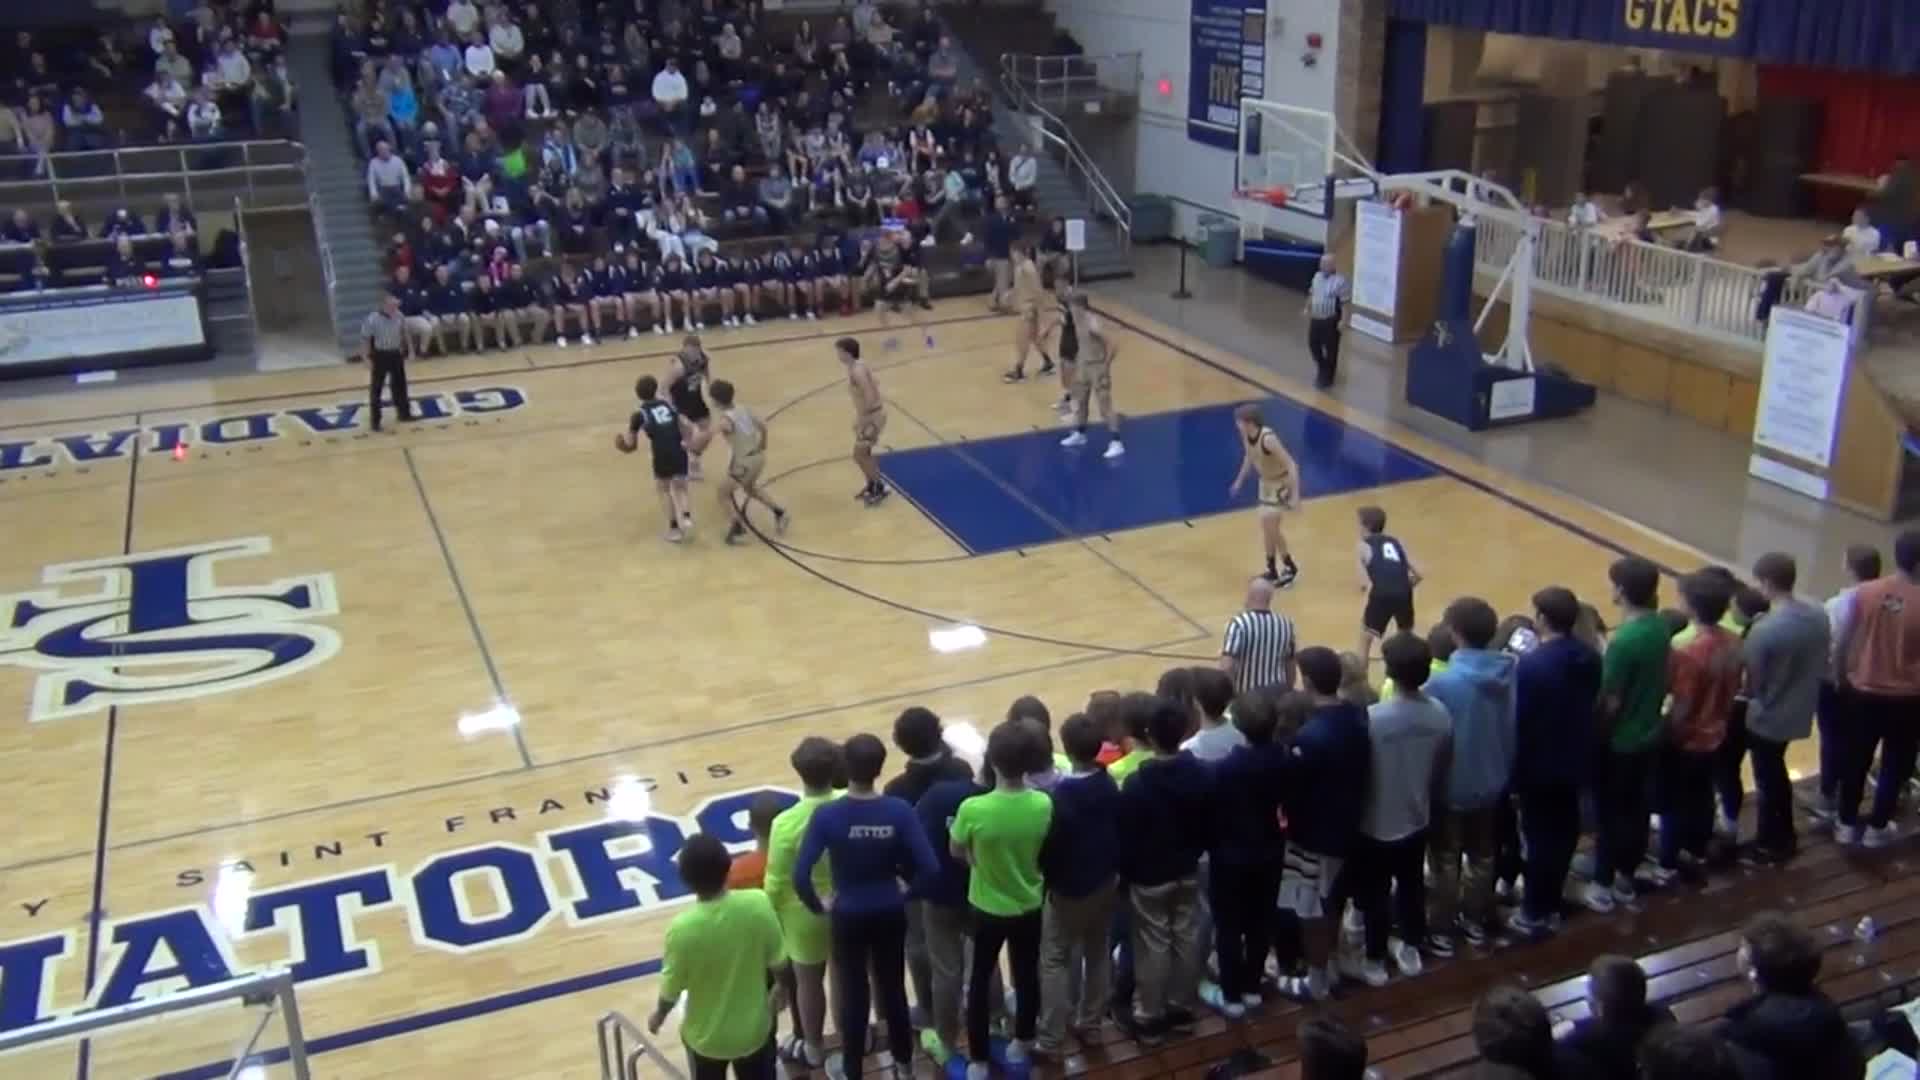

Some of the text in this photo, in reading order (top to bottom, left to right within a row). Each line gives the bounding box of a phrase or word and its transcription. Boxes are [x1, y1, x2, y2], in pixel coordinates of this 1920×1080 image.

[1625, 0, 1739, 38] GTACS
[650, 404, 673, 424] 12
[1383, 541, 1401, 562] 4
[175, 831, 390, 888] SAINT
